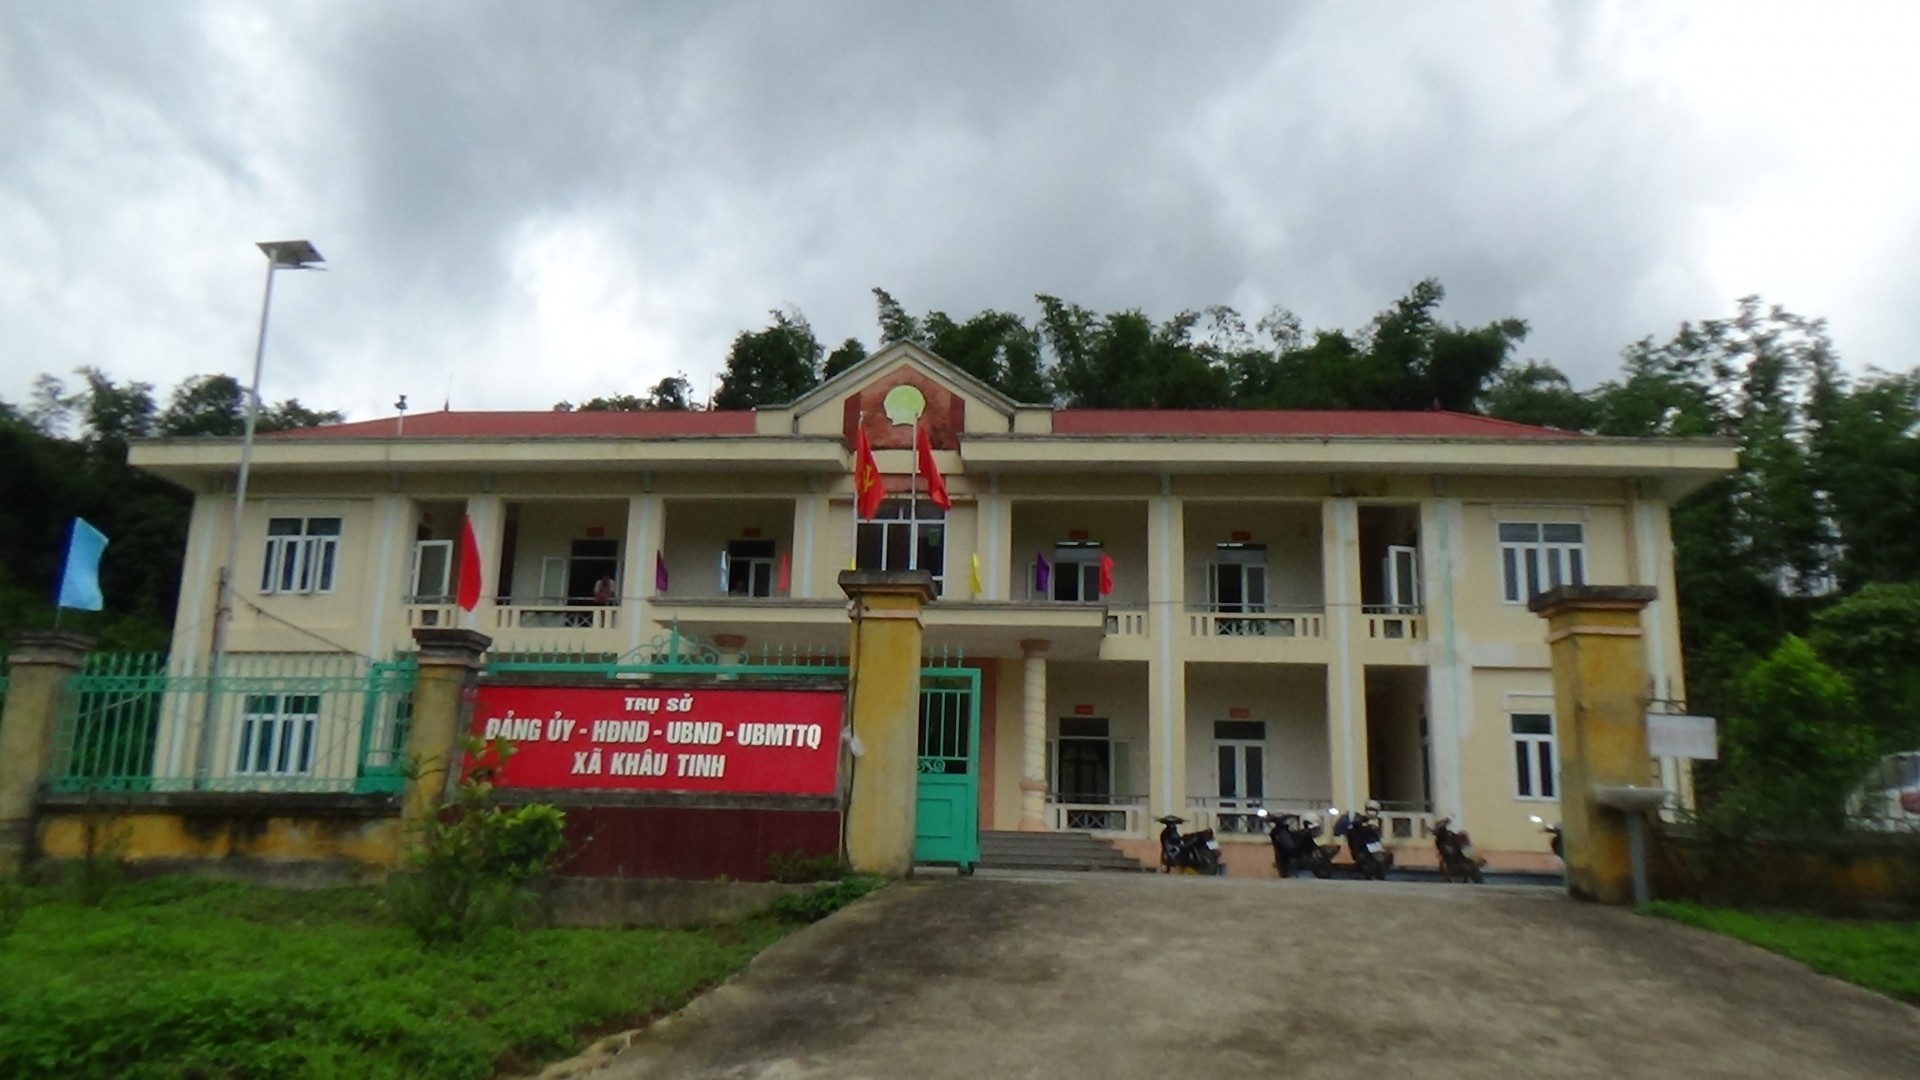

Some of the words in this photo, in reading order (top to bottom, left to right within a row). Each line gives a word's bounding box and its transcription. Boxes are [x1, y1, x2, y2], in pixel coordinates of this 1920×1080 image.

[624, 697, 660, 715] TRỤ
[666, 692, 694, 712] SỞ
[485, 710, 543, 741] ĐẢNG
[547, 711, 576, 742] ỦY
[591, 720, 650, 743] HĐND
[666, 721, 724, 745] UBND
[737, 722, 822, 750] UBMTTQ
[571, 747, 603, 775] XÃ
[609, 748, 669, 776] KHÂU
[677, 753, 726, 778] TINH
